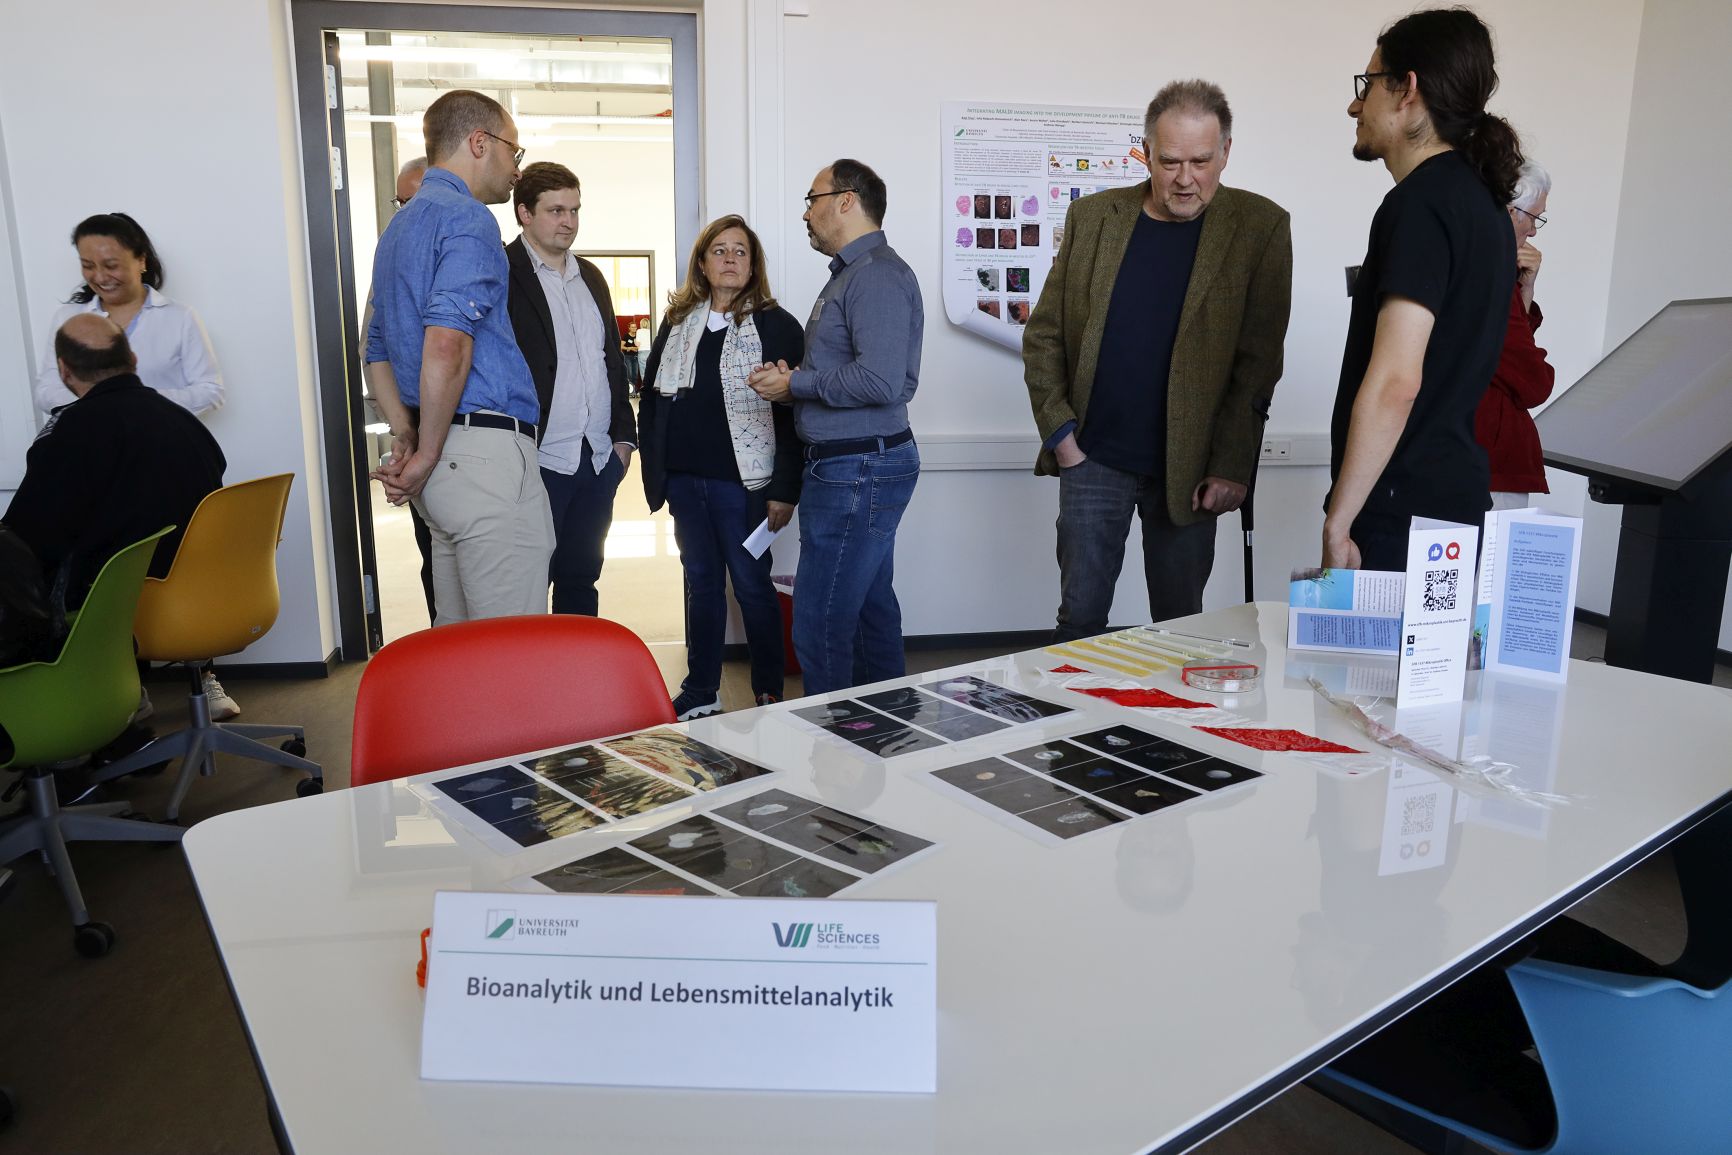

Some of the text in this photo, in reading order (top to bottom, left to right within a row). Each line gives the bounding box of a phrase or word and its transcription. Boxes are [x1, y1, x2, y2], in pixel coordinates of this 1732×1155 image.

[519, 918, 579, 928] UNIVERSITÄT
[817, 923, 843, 933] LIFE
[518, 927, 567, 936] BAYREUTH
[817, 933, 880, 944] SCIENCES
[466, 976, 894, 1012] Bioanalytik und Lebensmittelanalytik
